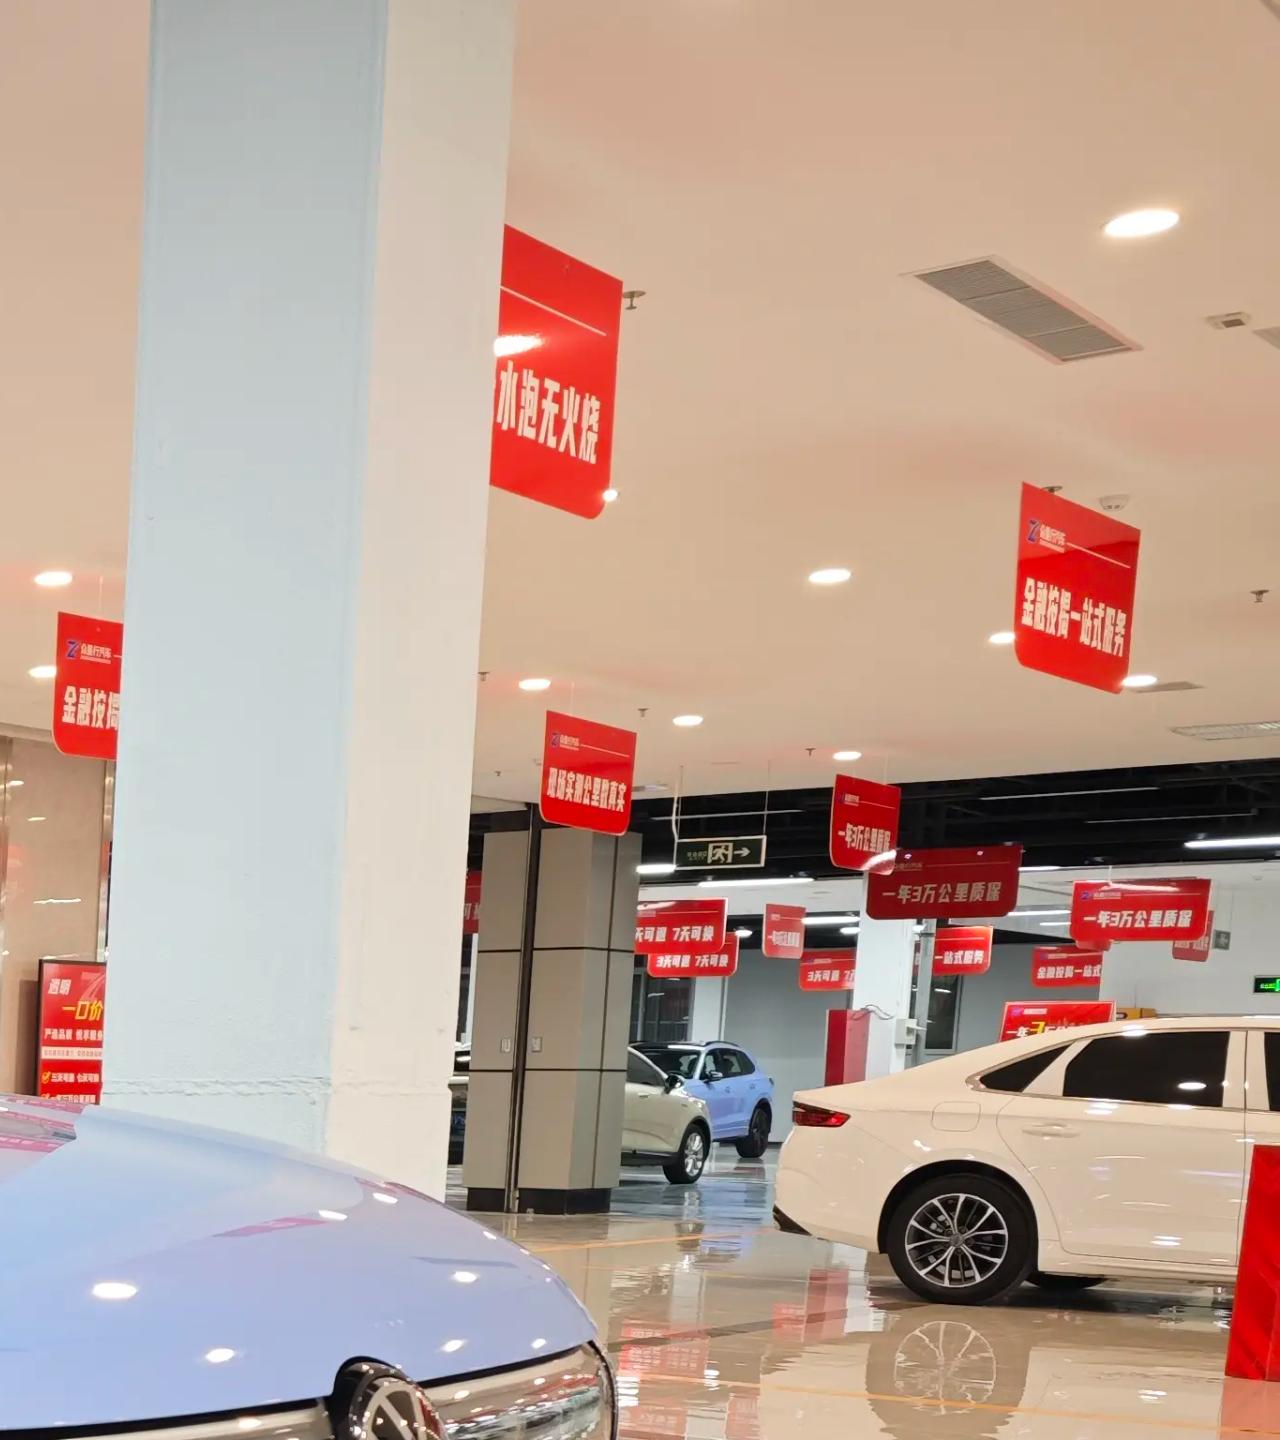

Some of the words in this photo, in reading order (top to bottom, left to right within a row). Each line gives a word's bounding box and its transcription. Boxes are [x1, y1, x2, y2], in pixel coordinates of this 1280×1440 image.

[495, 360, 601, 465] 水泡无火烧
[882, 881, 1003, 905] 一年3万公里质保
[1083, 909, 1193, 929] 一年3万公里质保
[62, 1000, 104, 1021] 一口价
